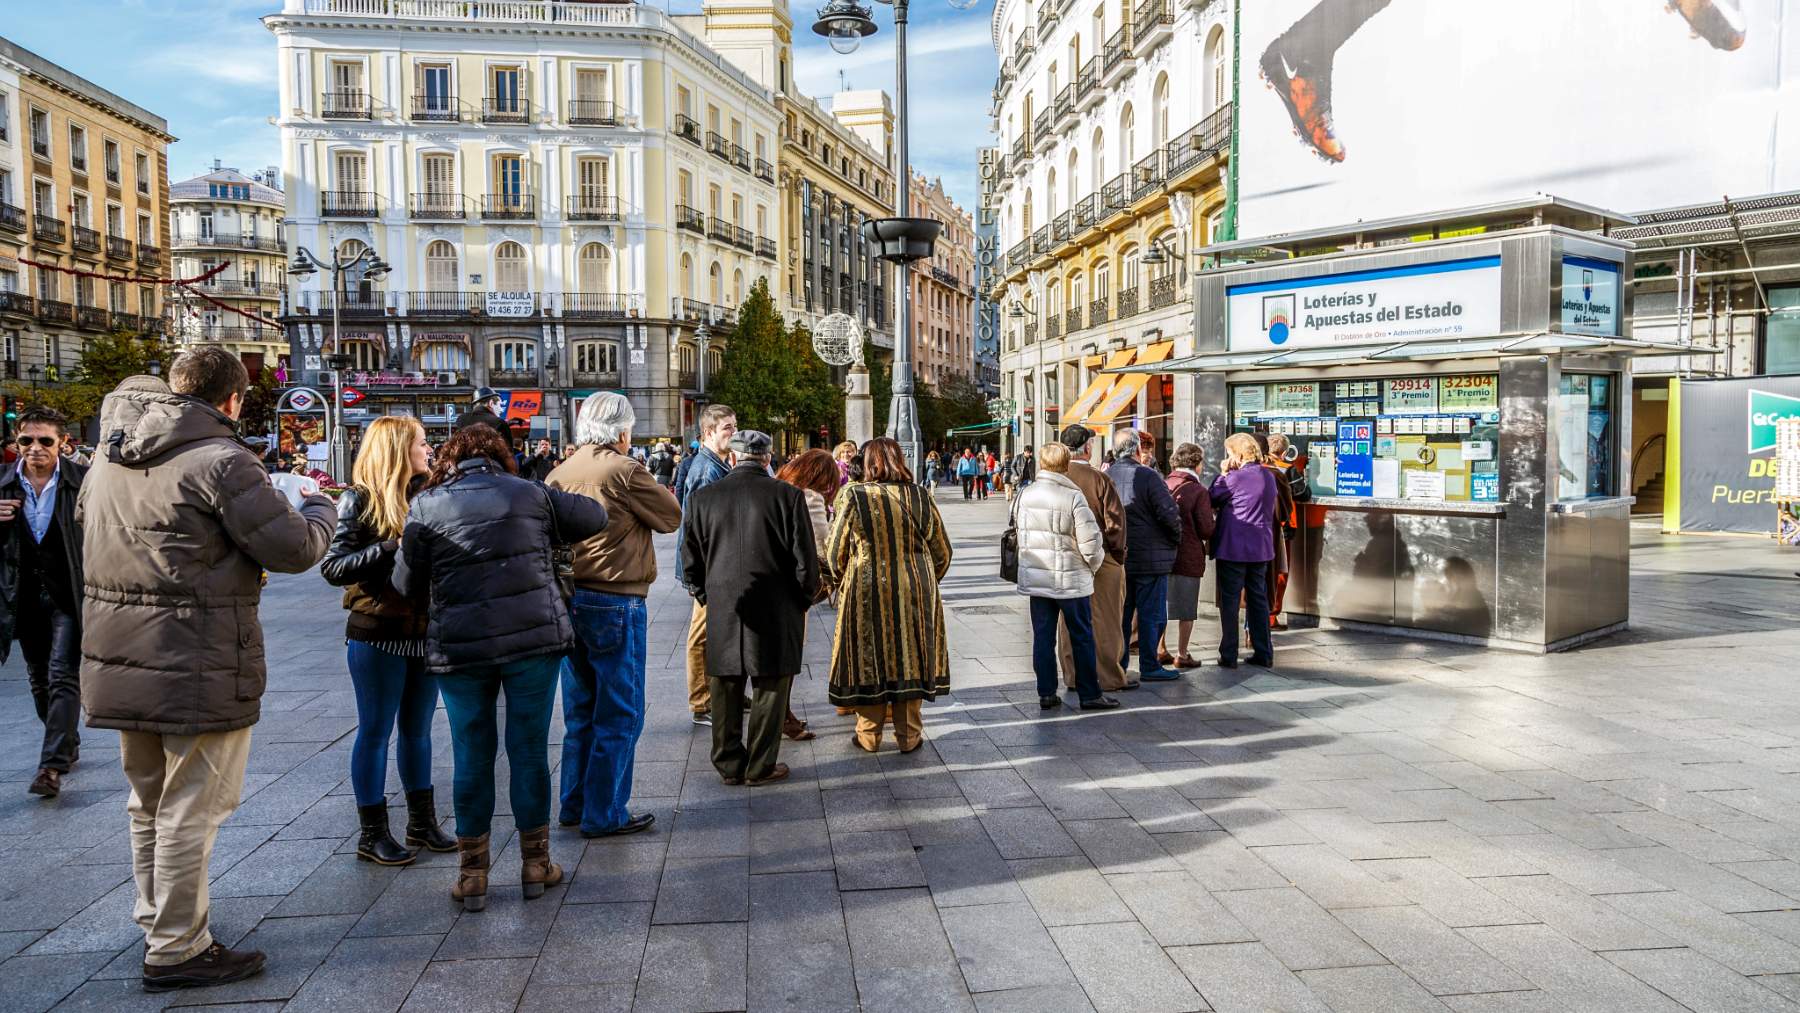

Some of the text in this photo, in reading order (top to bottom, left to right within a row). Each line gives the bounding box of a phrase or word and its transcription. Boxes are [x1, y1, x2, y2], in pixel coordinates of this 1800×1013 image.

[980, 149, 994, 226] HOTEL
[978, 235, 995, 341] MODERNO
[488, 291, 531, 301] SE ALQUILA
[1303, 291, 1377, 310] Loterías y
[488, 306, 532, 314] 91 436 27 27
[1584, 303, 1588, 314] y
[1588, 301, 1611, 315] Apuestas
[1303, 300, 1463, 331] Apuestas del Estado
[1573, 314, 1600, 327] del Estado
[1453, 324, 1462, 333] 59
[1391, 378, 1432, 391] 29914
[1444, 373, 1493, 388] 32304
[1288, 385, 1313, 394] 37368
[1401, 391, 1430, 399] Premio
[1457, 388, 1490, 397] Premio
